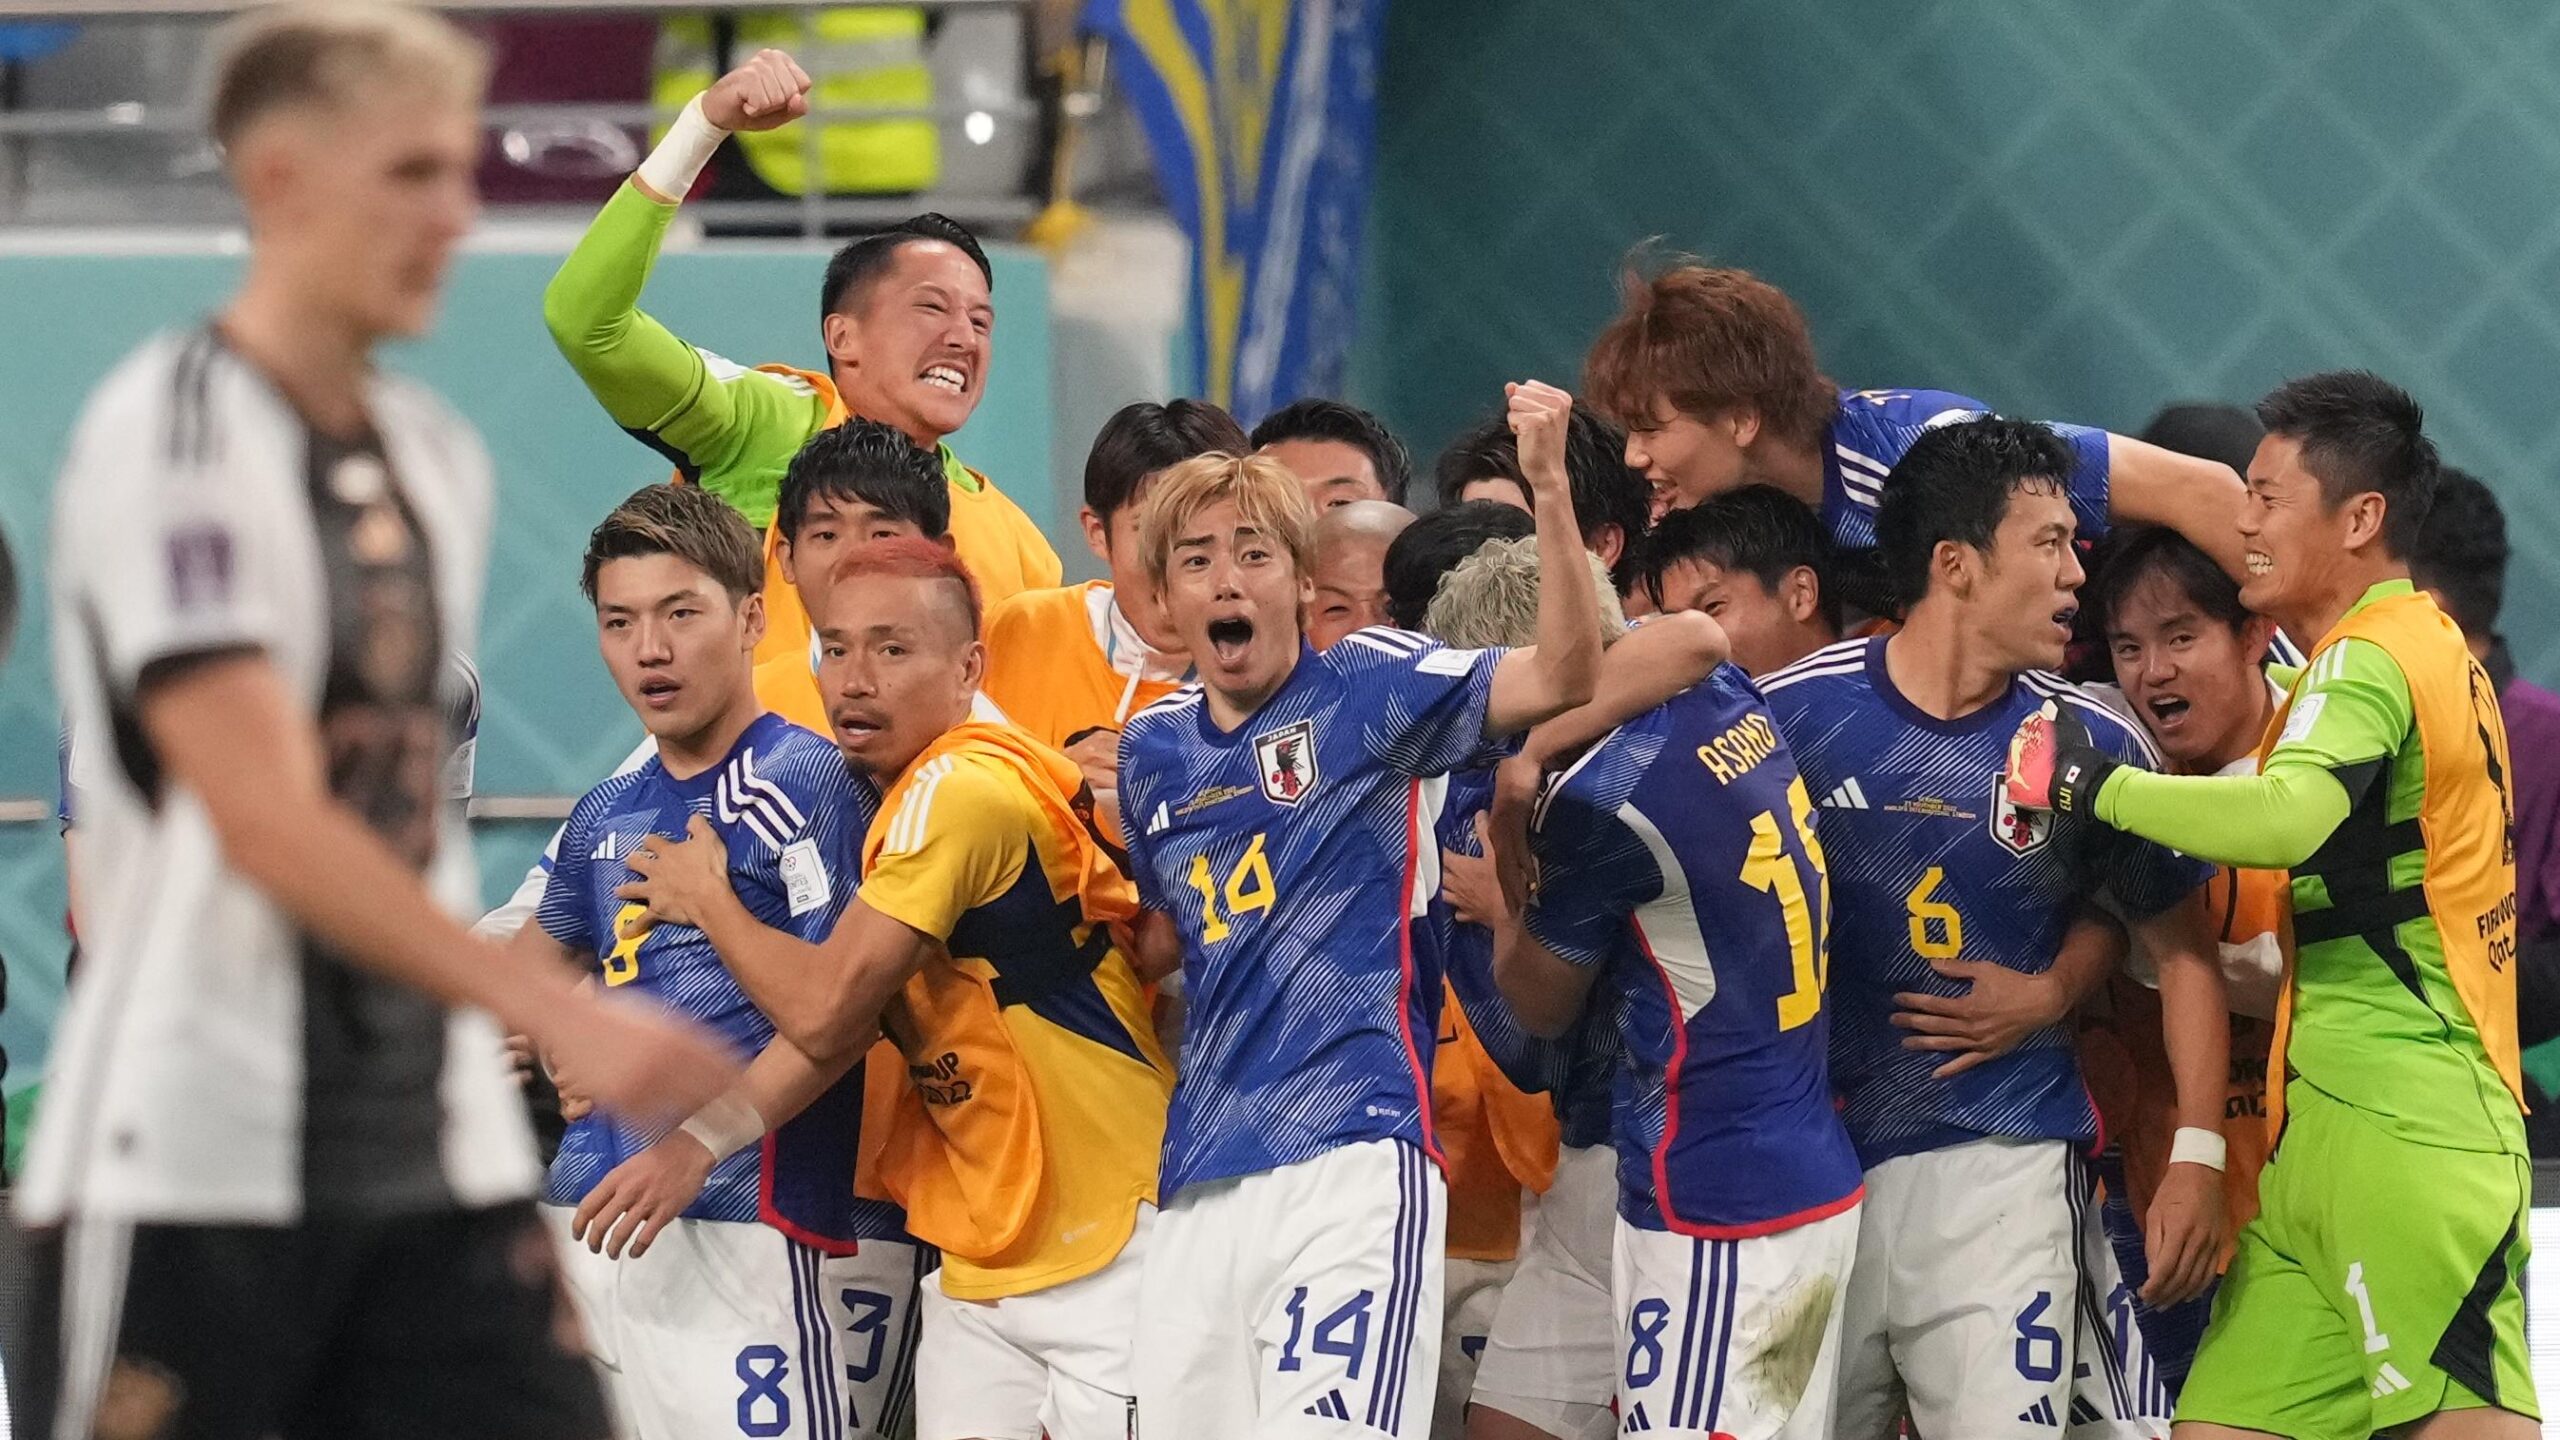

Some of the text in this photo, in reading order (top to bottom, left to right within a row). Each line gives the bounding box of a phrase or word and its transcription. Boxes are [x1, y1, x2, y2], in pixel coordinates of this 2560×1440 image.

[1268, 727, 1297, 742] JAPAN
[1697, 713, 1776, 786] ASANO
[2060, 787, 2072, 811] EIJI
[1188, 832, 1276, 945] 14
[1907, 867, 1962, 958] 6
[2476, 904, 2500, 939] FIFA
[1278, 1286, 1374, 1380] 14
[1626, 1298, 1670, 1389] 8
[2016, 1291, 2062, 1383] 6
[2344, 1261, 2389, 1354] 1
[736, 1345, 790, 1438] 8
